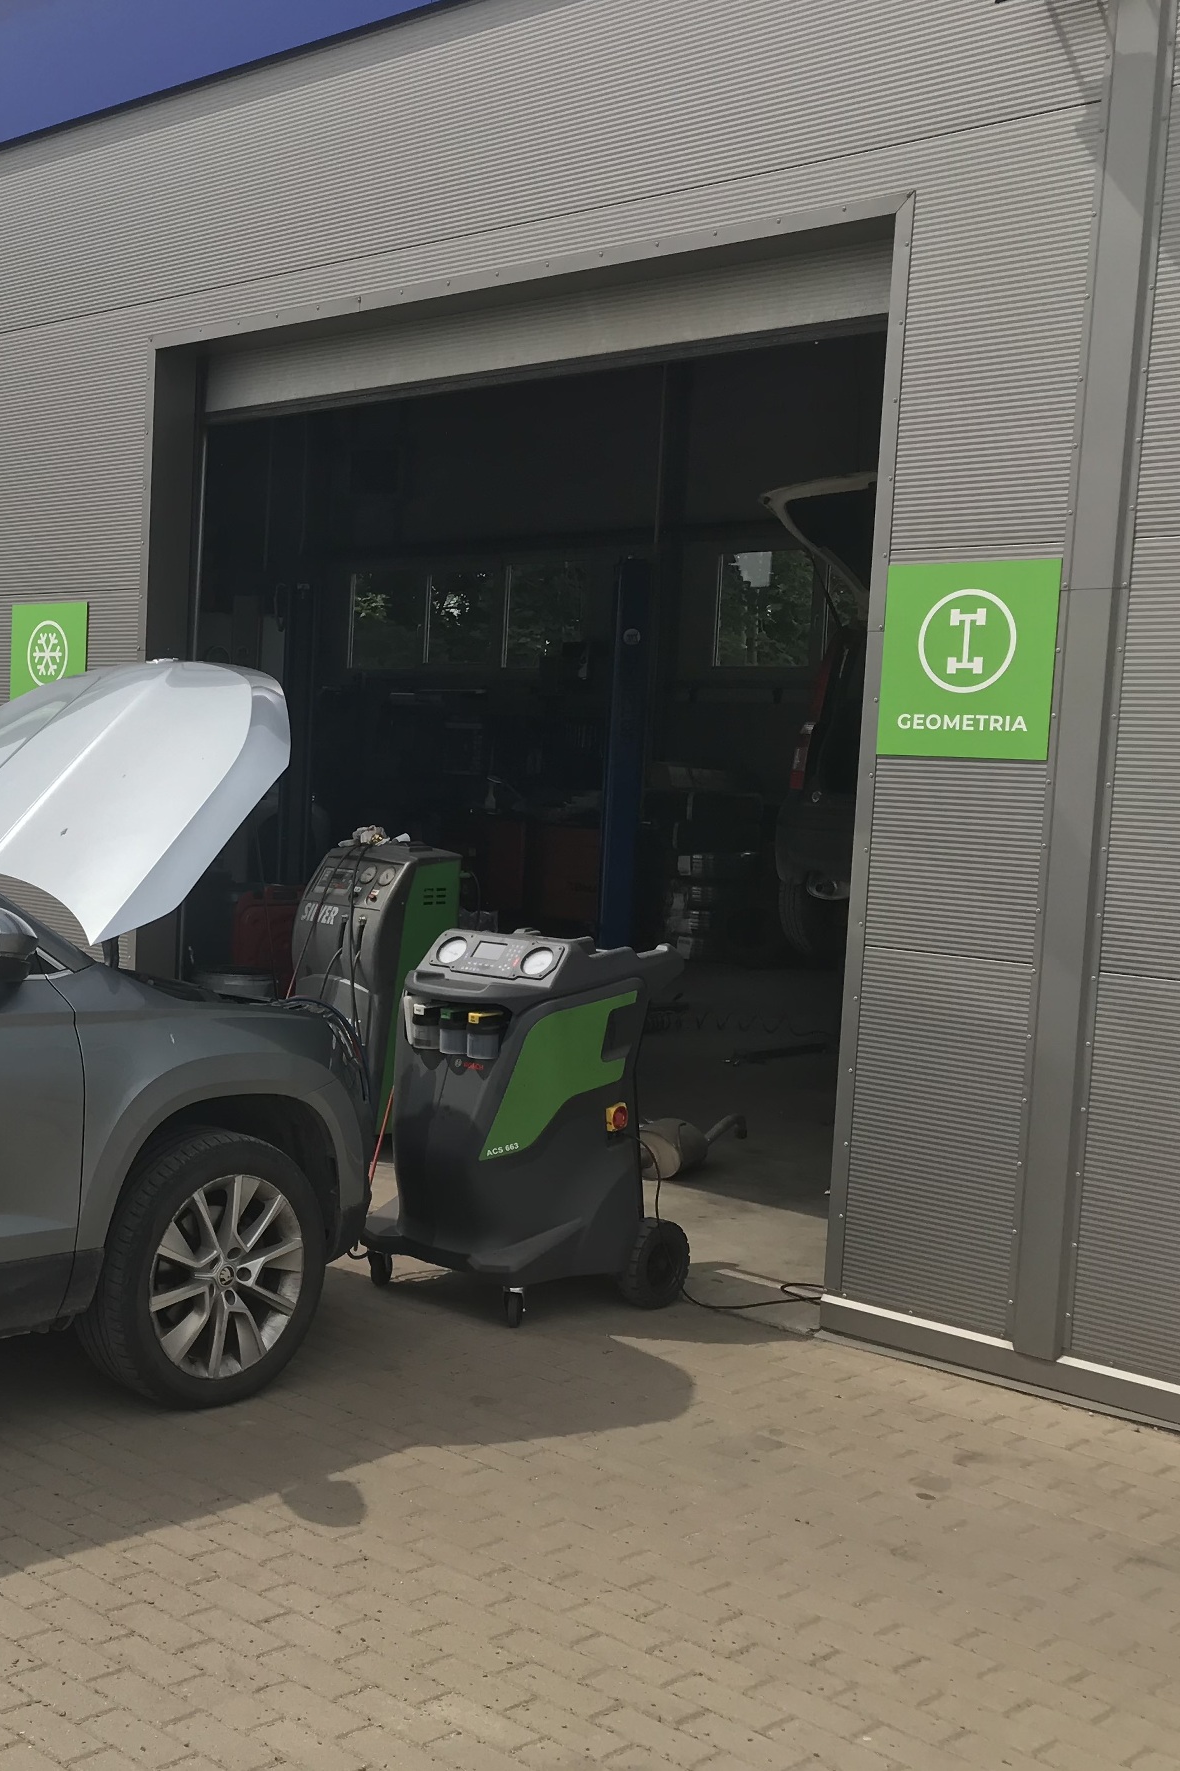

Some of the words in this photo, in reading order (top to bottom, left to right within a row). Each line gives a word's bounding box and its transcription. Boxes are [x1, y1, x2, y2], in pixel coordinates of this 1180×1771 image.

[897, 713, 1028, 732] GEOMETRIA
[486, 1146, 504, 1156] ACS
[505, 1142, 520, 1152] 663
